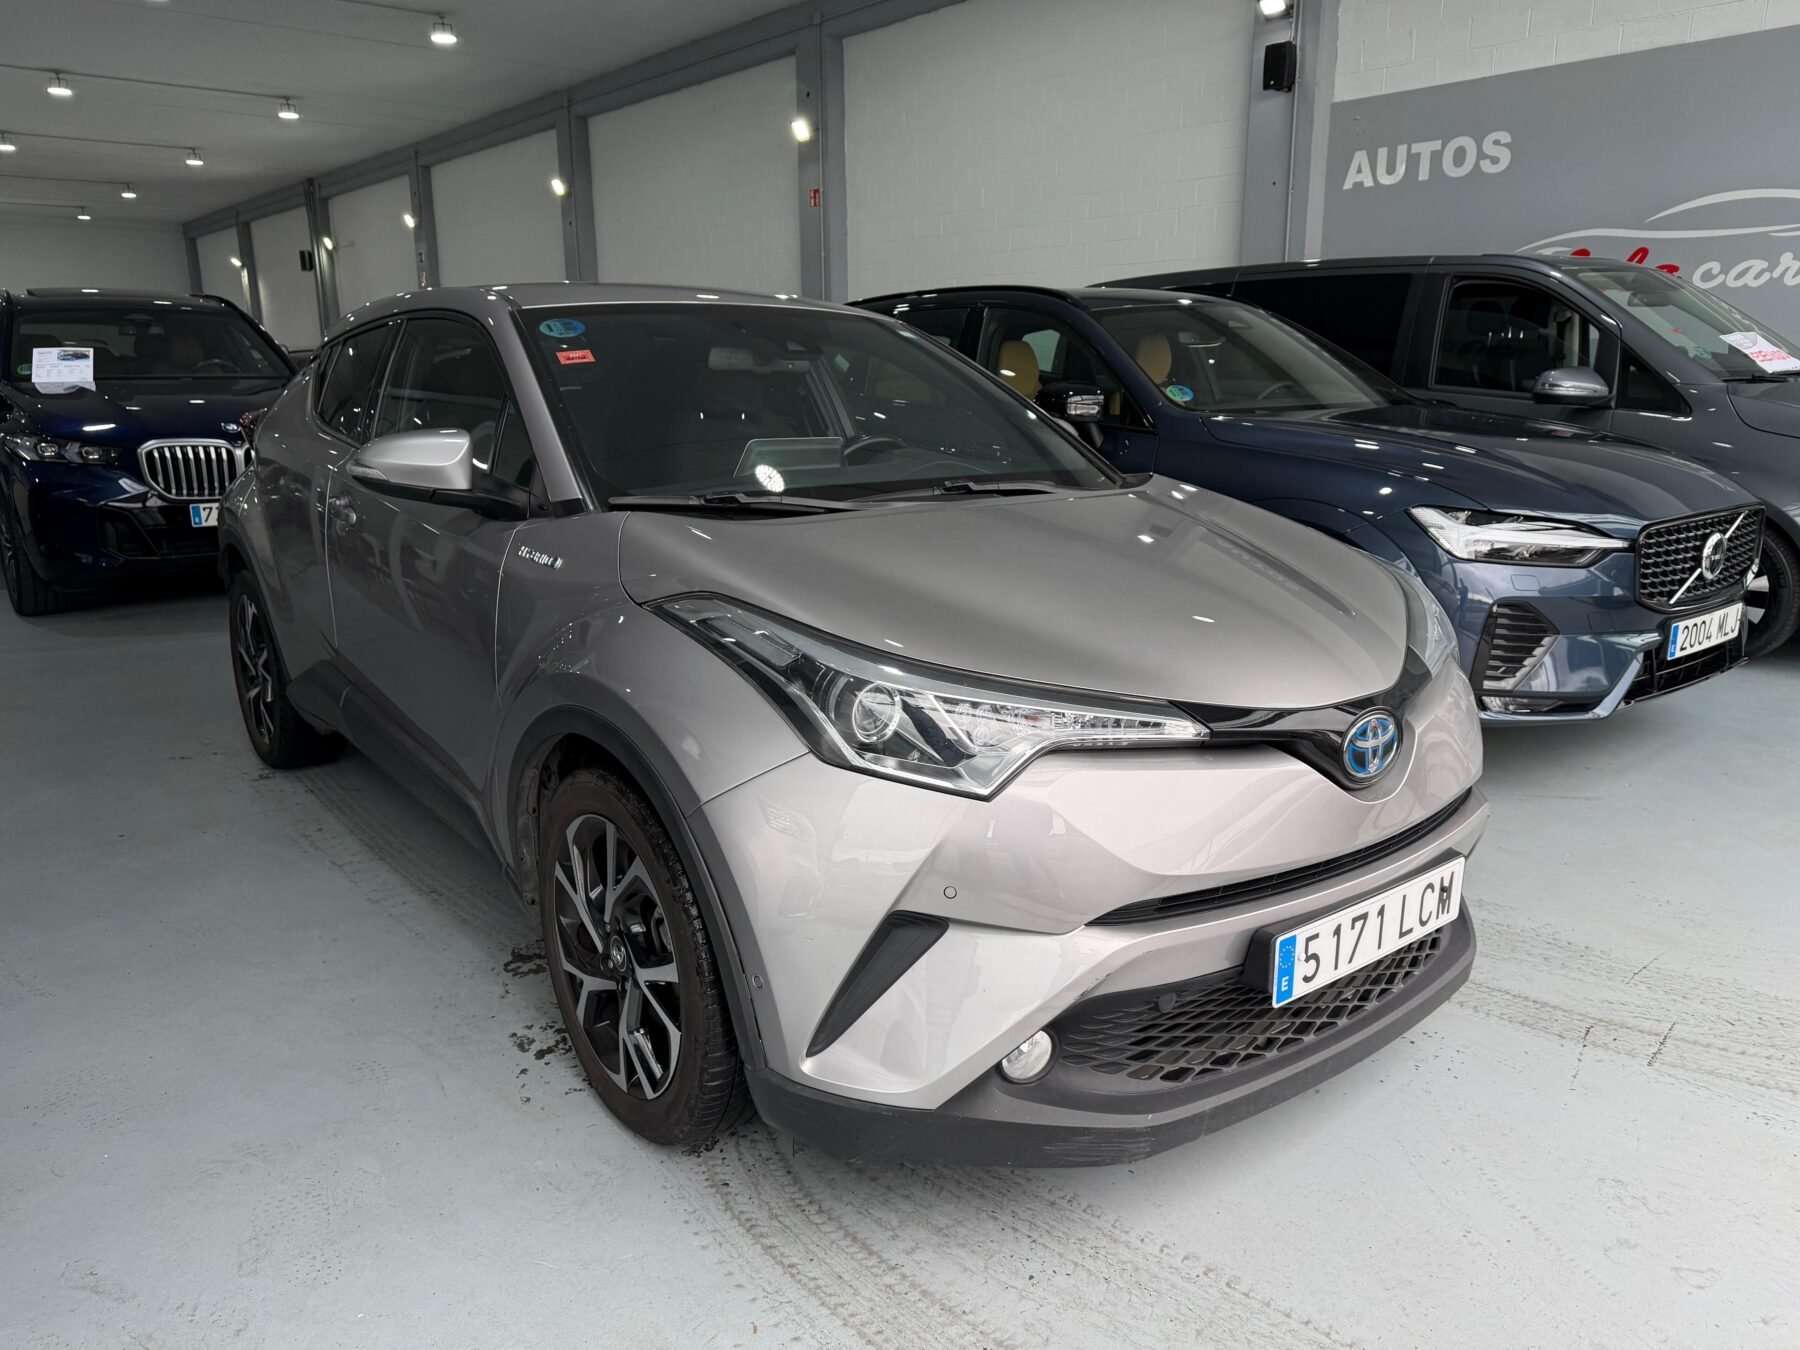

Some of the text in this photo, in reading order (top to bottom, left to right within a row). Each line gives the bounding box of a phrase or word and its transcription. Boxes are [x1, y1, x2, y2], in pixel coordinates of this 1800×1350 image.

[1342, 130, 1512, 190] AUTOS
[1680, 607, 1740, 652] 2004 MLJ
[1301, 870, 1455, 984] 5171 LCM
[1280, 975, 1290, 992] E
